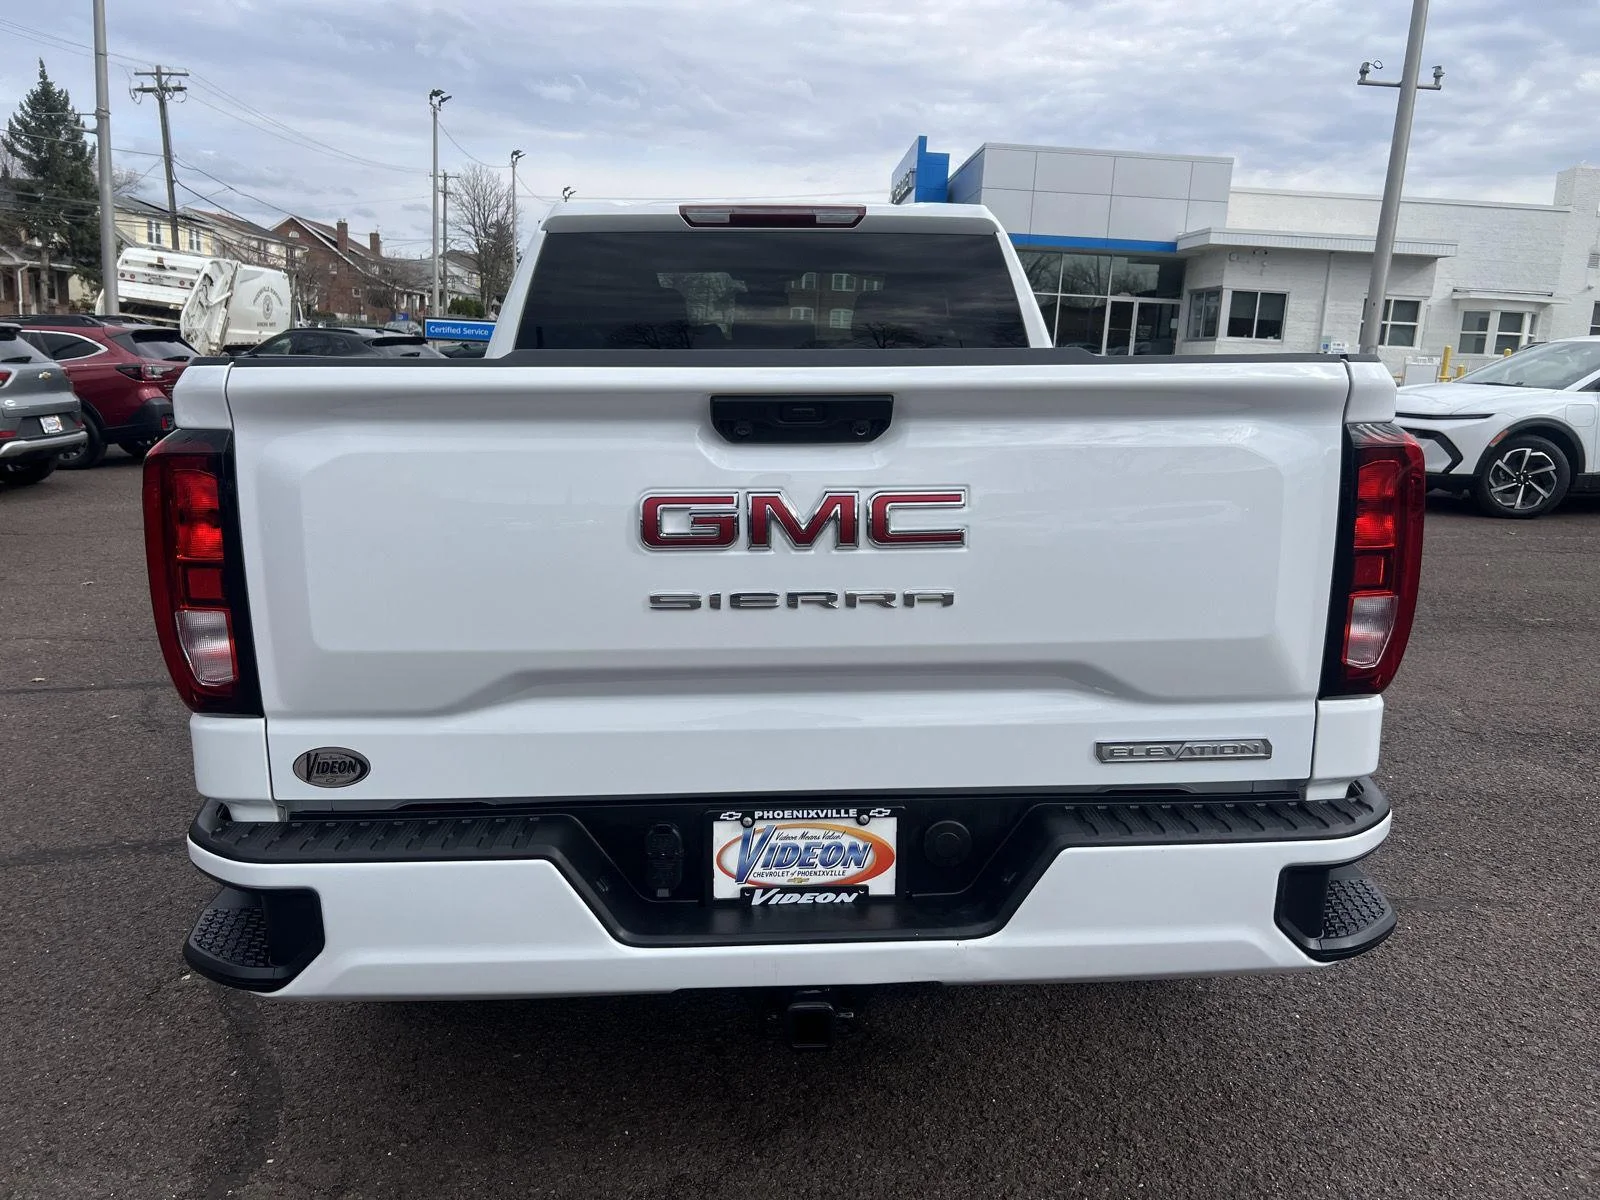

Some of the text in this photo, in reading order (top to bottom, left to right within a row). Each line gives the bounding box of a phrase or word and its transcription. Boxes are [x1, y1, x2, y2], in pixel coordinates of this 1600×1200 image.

[429, 325, 489, 336] Certified Service
[639, 489, 966, 551] GMC
[649, 588, 955, 610] SIERRA
[1109, 743, 1260, 757] ELEVATION
[306, 753, 356, 782] VIDEON
[754, 809, 858, 819] PHOENIXVILLE
[775, 830, 846, 841] Videon Means Value!
[735, 825, 872, 884] VIDEON
[752, 870, 789, 878] CHEVROLET
[797, 869, 847, 877] PHOENIXVILLE
[751, 888, 859, 906] VIDEON
